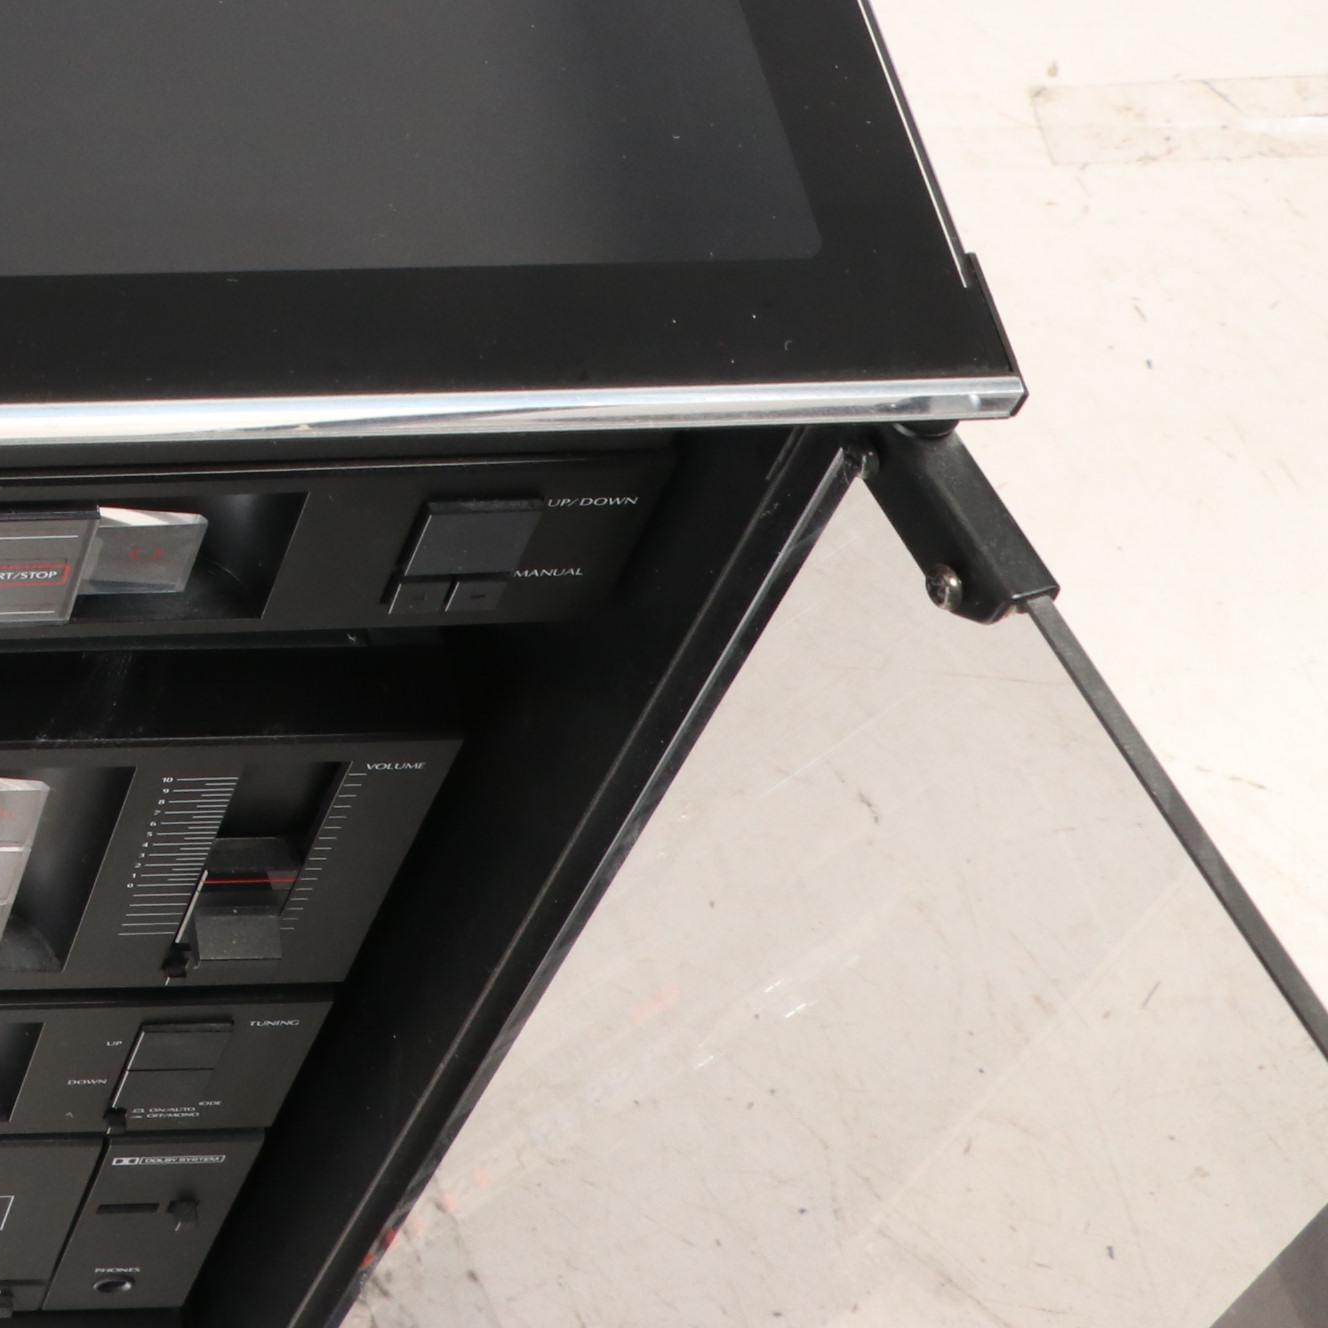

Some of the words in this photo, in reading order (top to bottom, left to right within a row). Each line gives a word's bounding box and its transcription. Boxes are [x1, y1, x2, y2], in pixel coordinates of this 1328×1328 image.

[547, 497, 638, 507] UP/DOWN
[514, 568, 583, 577] MANUAL
[366, 762, 426, 770] VOLUME
